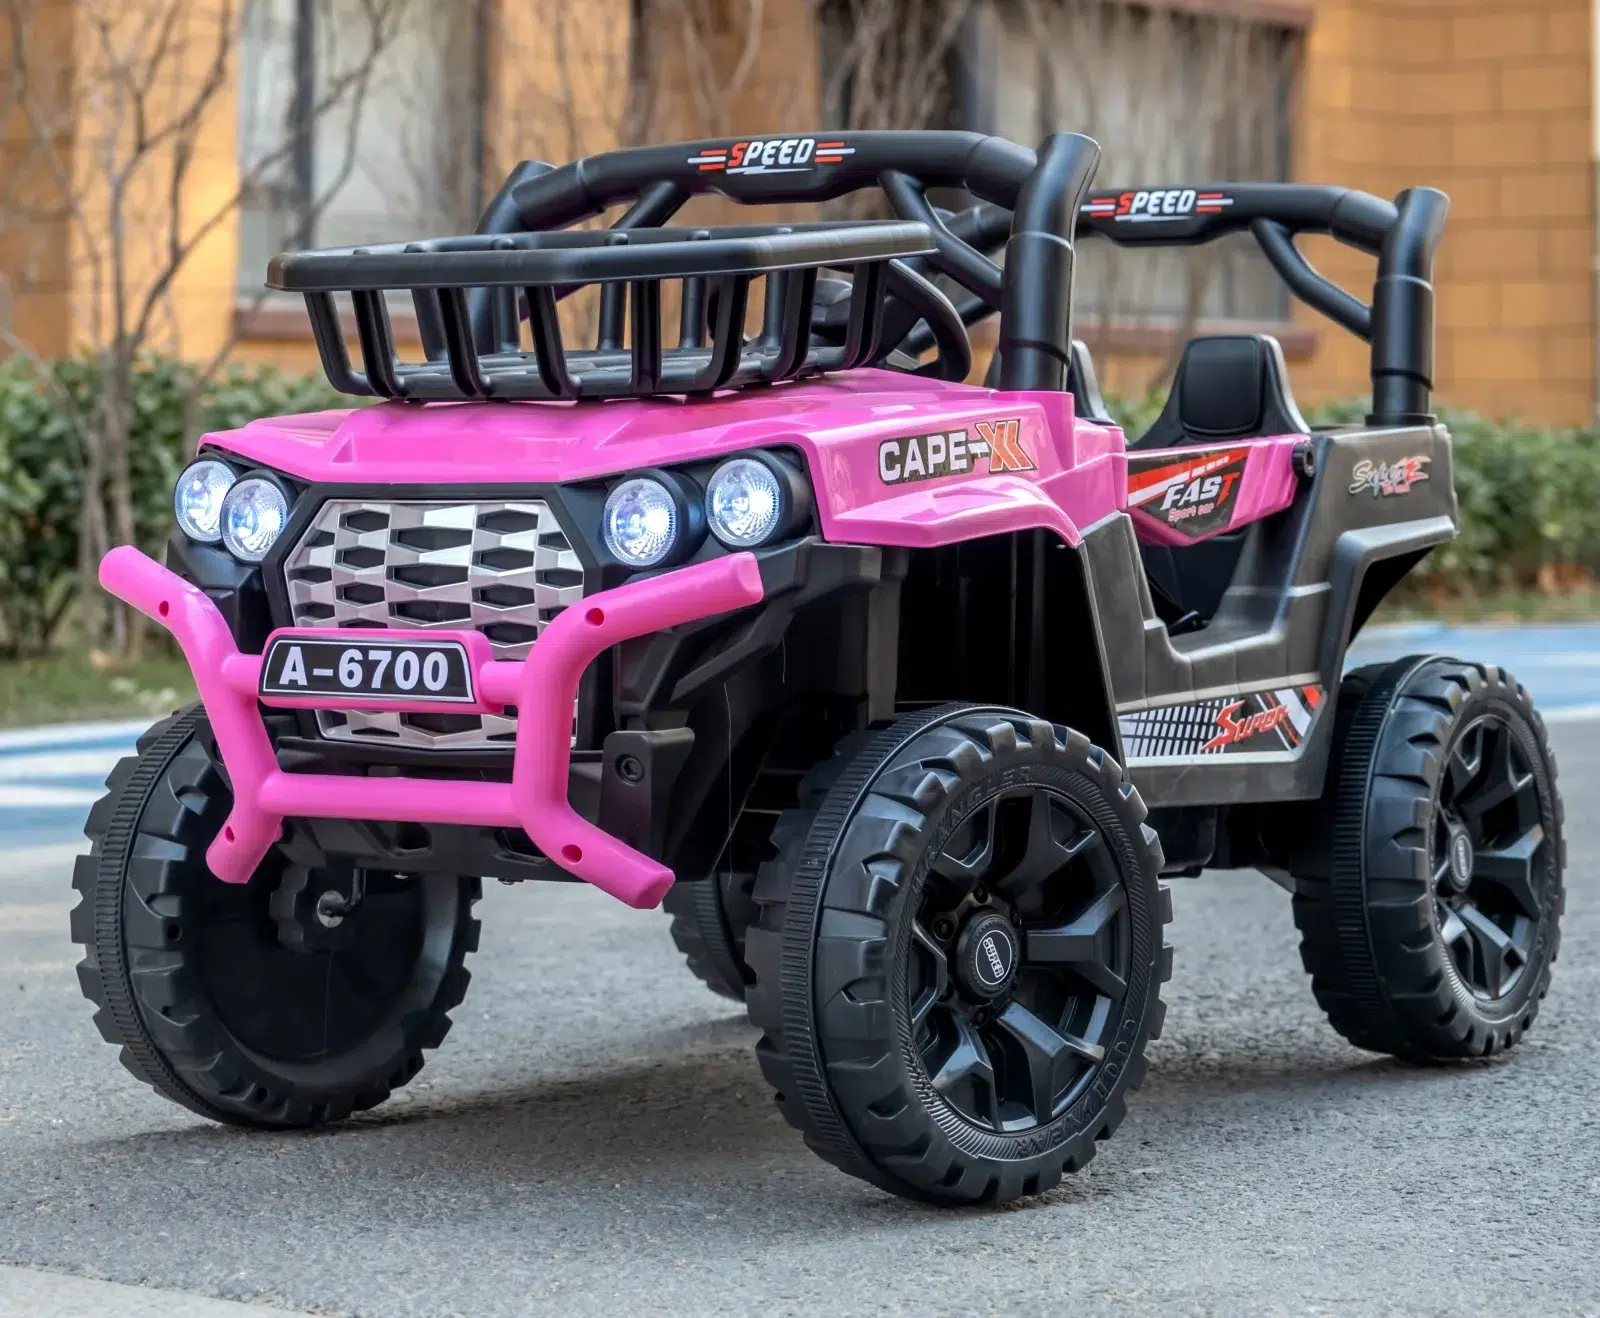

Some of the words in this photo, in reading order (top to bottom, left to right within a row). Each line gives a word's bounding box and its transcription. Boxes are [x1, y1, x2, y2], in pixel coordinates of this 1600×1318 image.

[728, 139, 815, 167] SPEED
[1116, 190, 1196, 214] SPEED
[1160, 471, 1240, 511] FAST
[1168, 505, 1196, 522] Sport
[279, 646, 449, 691] A-6700
[982, 937, 1005, 978] SUPER
